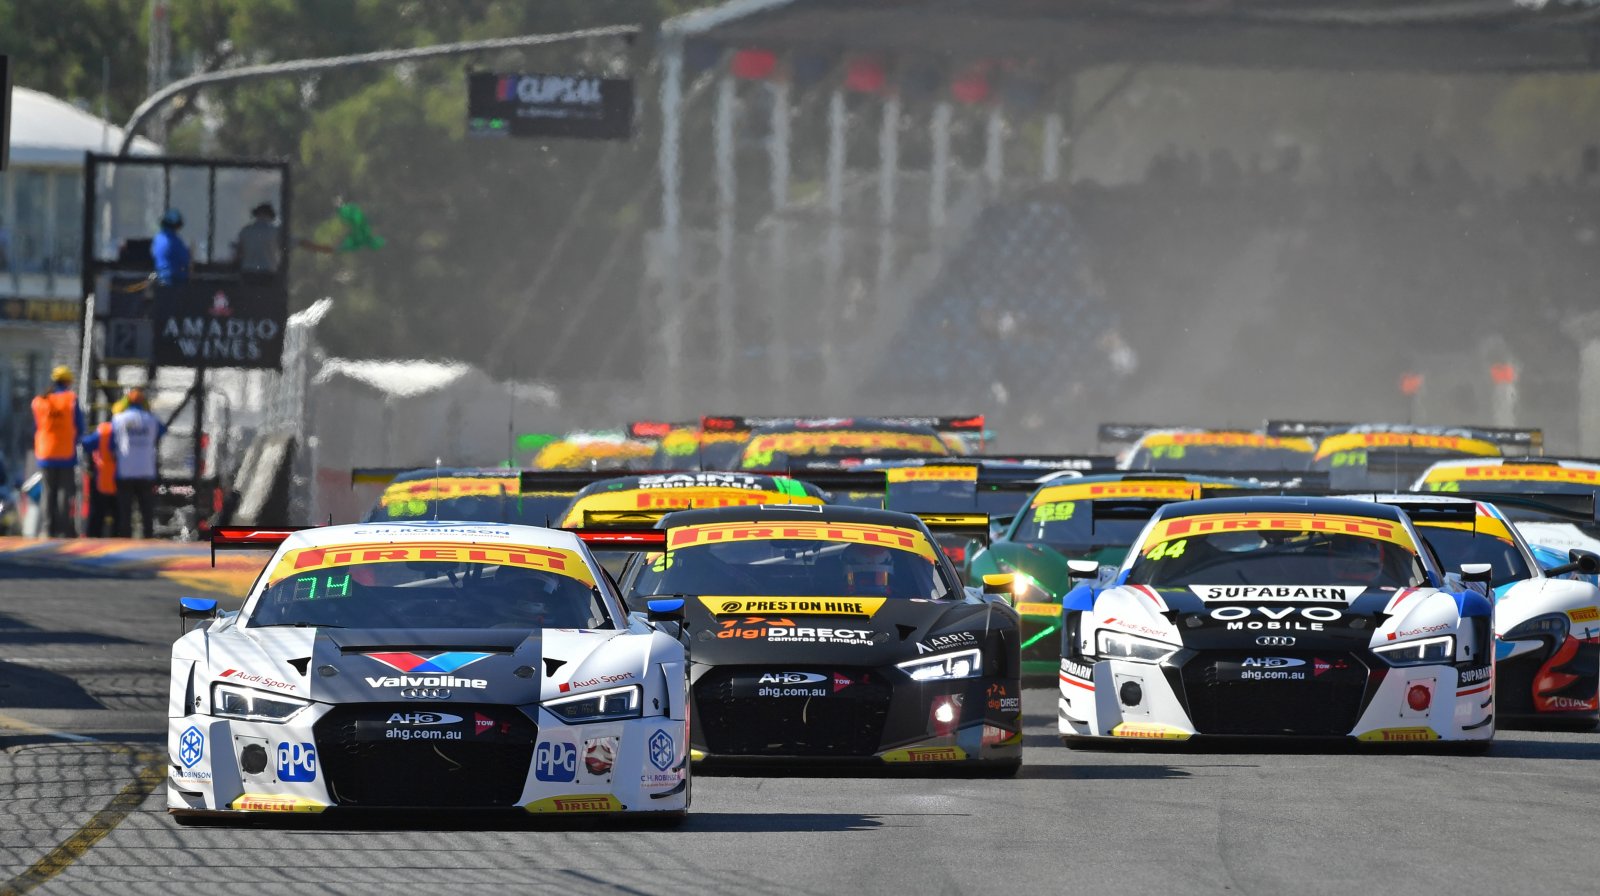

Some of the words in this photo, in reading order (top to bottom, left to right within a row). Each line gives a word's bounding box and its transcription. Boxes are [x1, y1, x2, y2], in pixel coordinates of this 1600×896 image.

[162, 316, 279, 339] AMADIO
[178, 337, 260, 360] WINES
[400, 527, 510, 536] ROBINSON
[1166, 512, 1395, 539] PIRELLI
[671, 522, 916, 548] PIRELLI
[293, 542, 567, 571] PIRELLI
[1146, 539, 1188, 561] 44
[296, 575, 350, 600] 74
[1207, 587, 1347, 601] SUPABARN
[745, 601, 822, 612] PRESTON
[825, 602, 864, 614] HIRE
[1210, 606, 1343, 621] OVO
[1226, 621, 1325, 632] MOBILE
[1399, 628, 1422, 637] Audi
[1422, 622, 1451, 634] Sport
[830, 637, 874, 647] imaging
[931, 631, 975, 647] ARRIS
[236, 671, 261, 683] Audi
[261, 677, 297, 691] Sport
[364, 675, 488, 689] Valvoline
[573, 677, 601, 689] Audi
[600, 671, 635, 684] Sport
[834, 678, 851, 686] TOW
[1240, 670, 1305, 680] ahg.com.au
[758, 686, 827, 697] ahg.com.au
[385, 712, 438, 724] AHG
[385, 727, 462, 740] ahg.com.au
[1382, 729, 1429, 740] PIRELLI
[278, 742, 316, 777] PPG
[536, 743, 576, 776] PPG
[908, 748, 956, 761] PIRELLI
[241, 796, 297, 811] PIRELLI
[553, 797, 611, 811] PIRELLI
